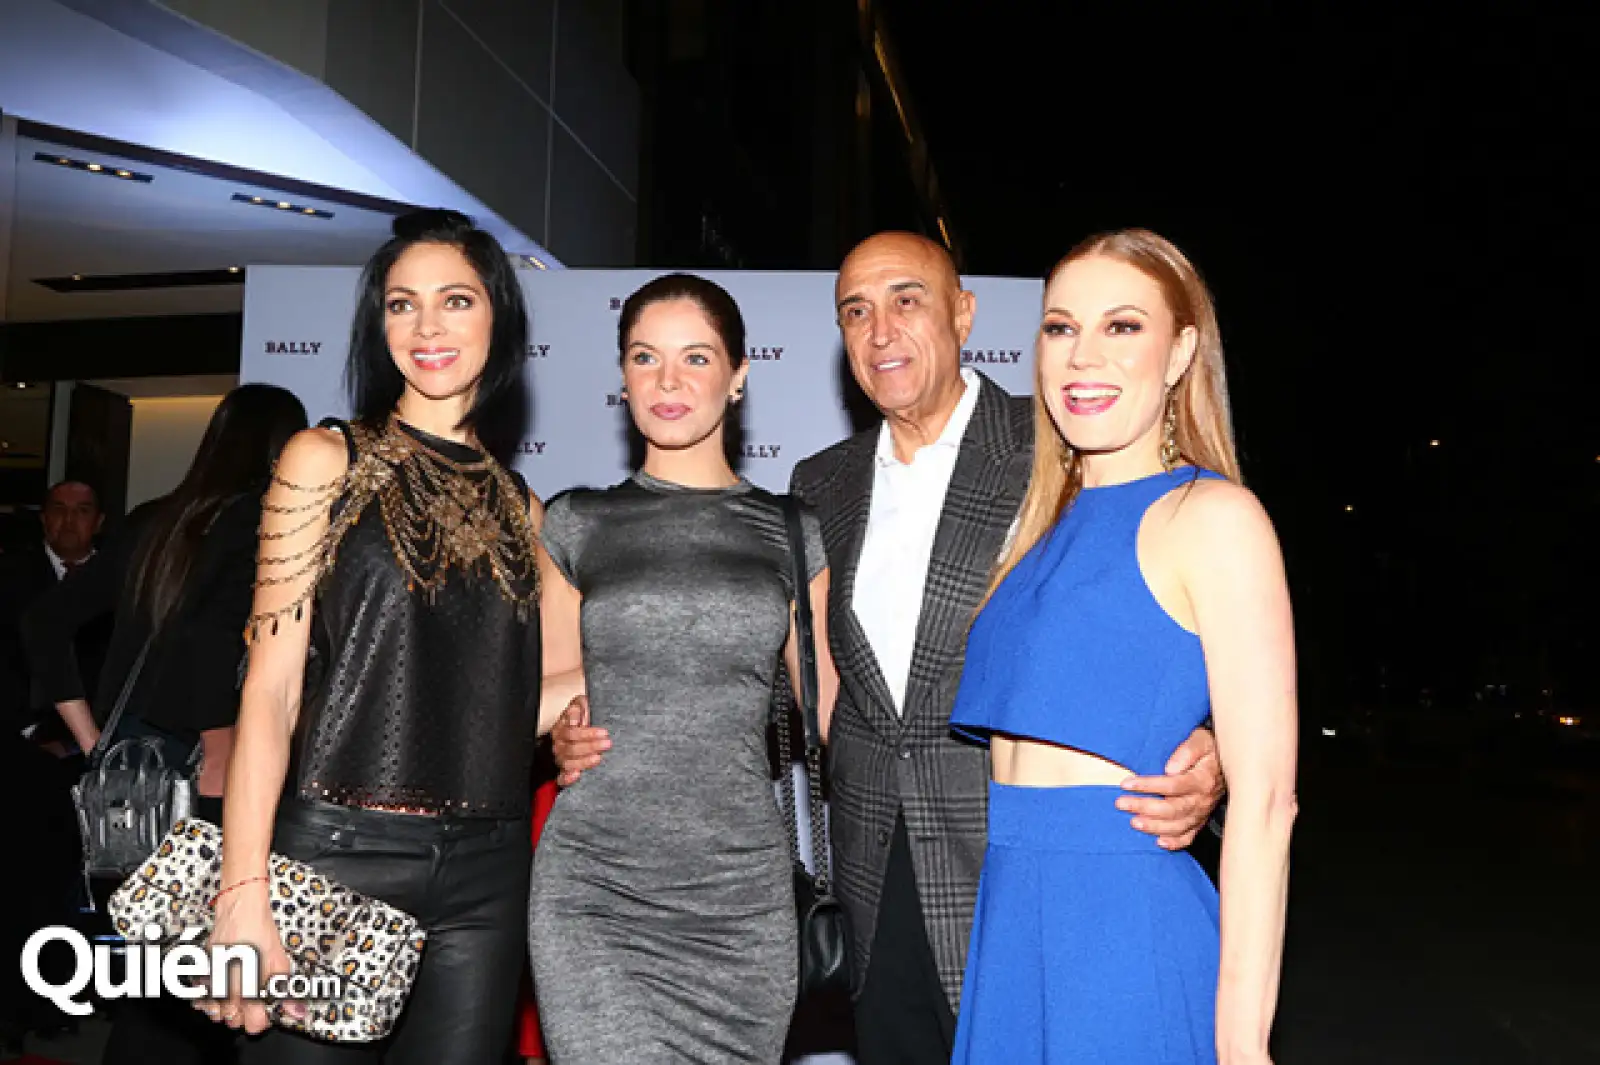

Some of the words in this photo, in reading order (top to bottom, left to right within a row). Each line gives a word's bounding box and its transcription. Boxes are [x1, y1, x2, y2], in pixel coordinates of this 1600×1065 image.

[264, 341, 322, 355] BALLY
[745, 347, 784, 361] LLY
[961, 349, 1023, 364] BALLY
[743, 444, 781, 458] LLY
